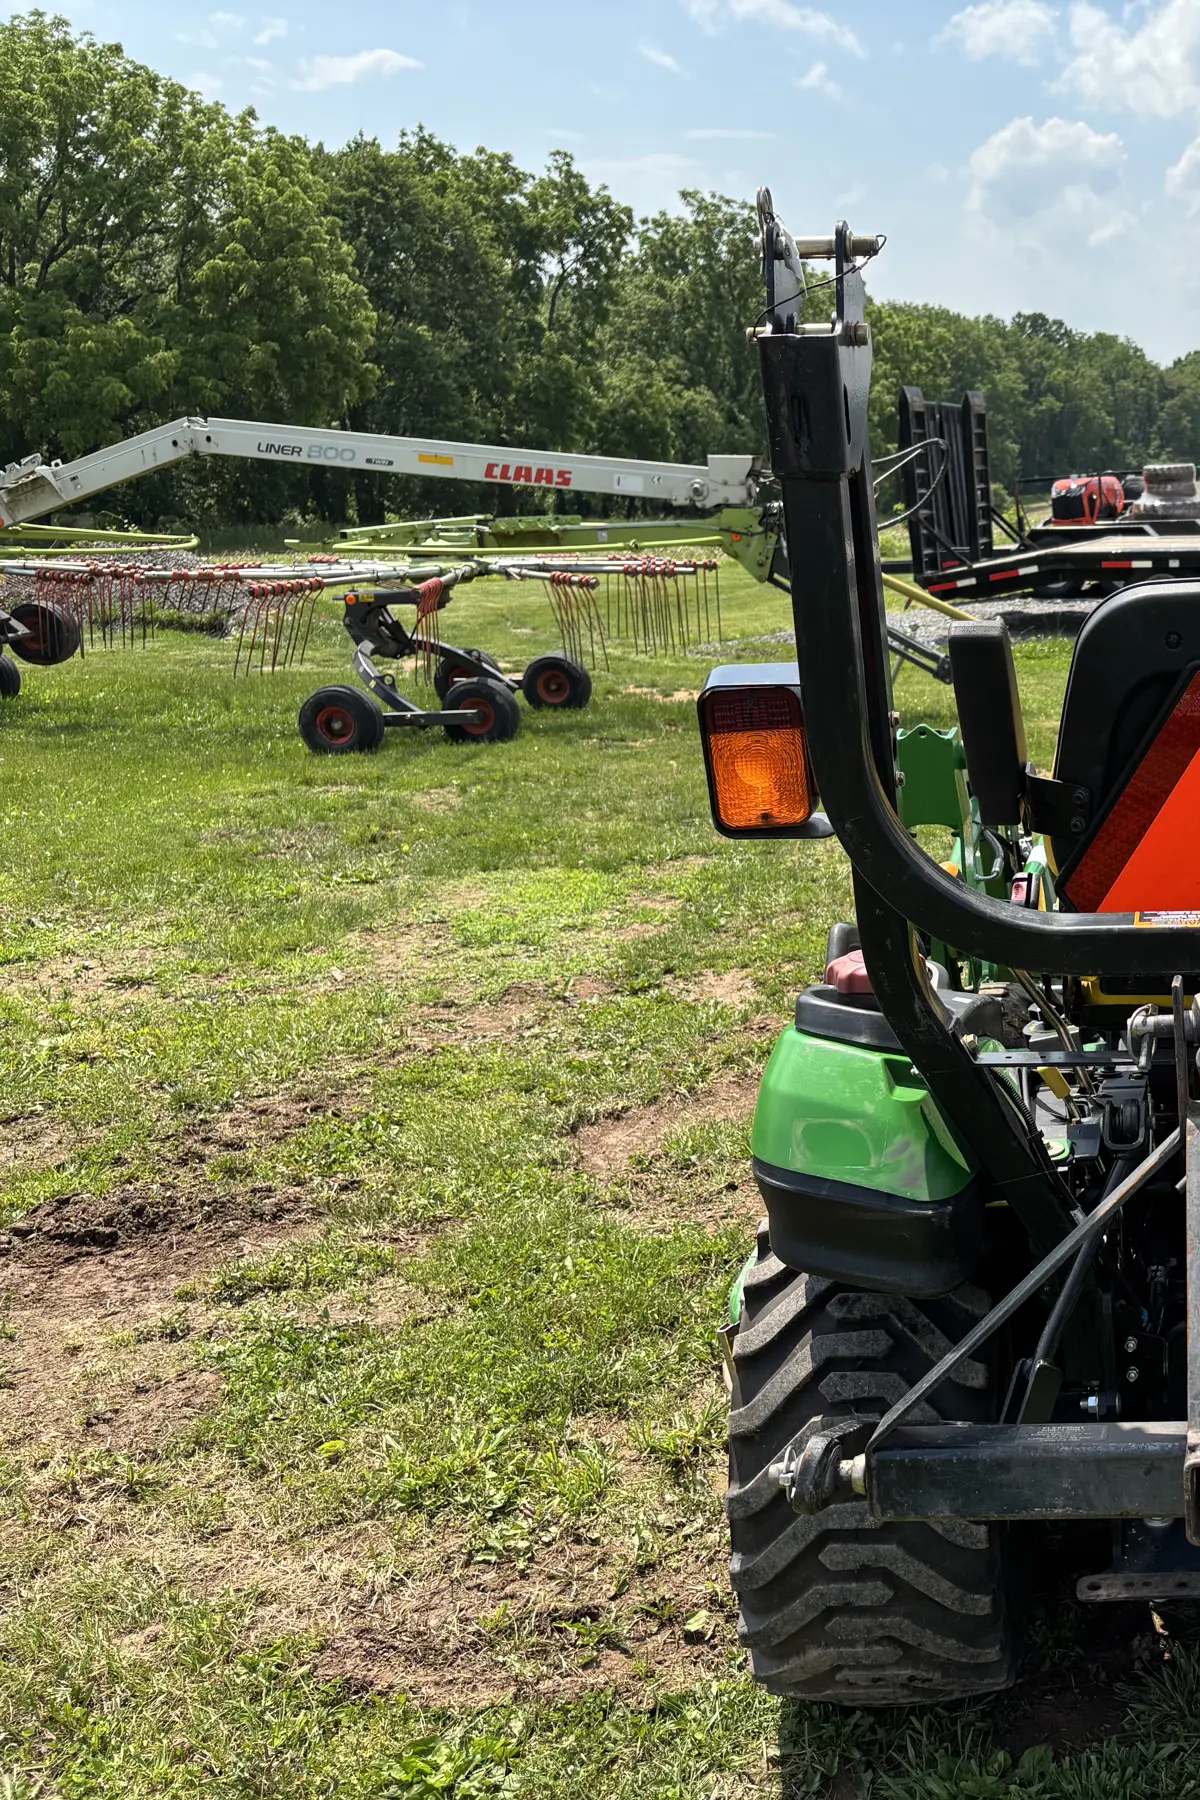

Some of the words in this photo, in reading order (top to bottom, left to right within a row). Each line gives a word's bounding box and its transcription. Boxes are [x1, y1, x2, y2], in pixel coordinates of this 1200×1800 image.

[256, 441, 303, 457] LINER
[307, 444, 356, 462] 800
[484, 462, 573, 487] CLAAS
